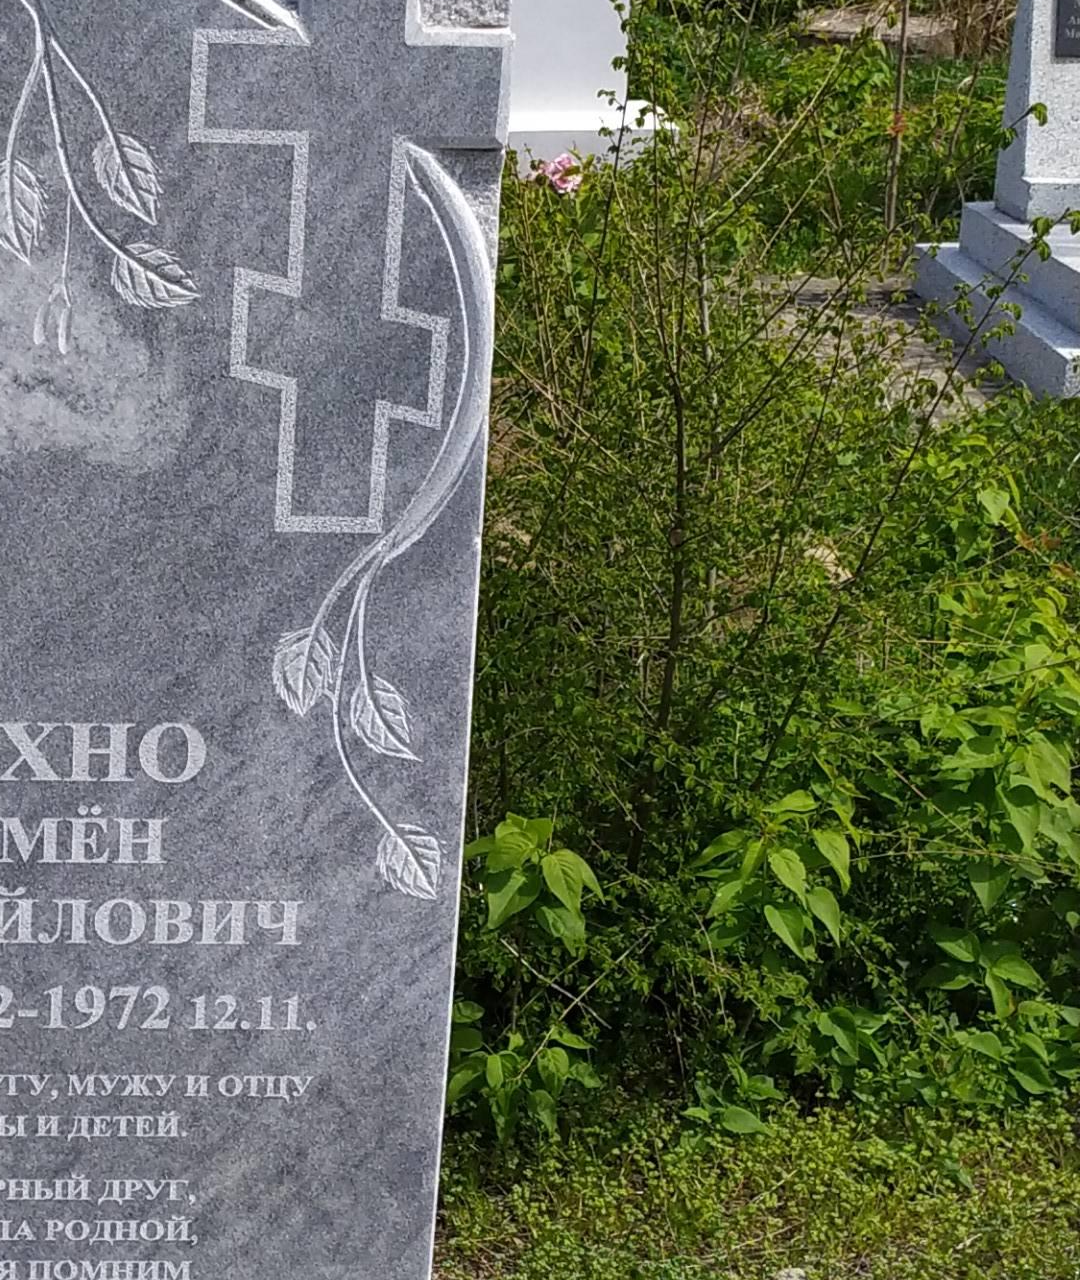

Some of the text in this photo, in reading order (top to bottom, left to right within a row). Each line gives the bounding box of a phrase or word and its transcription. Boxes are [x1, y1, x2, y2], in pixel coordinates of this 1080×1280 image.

[189, 994, 317, 1031] 12.11.
[67, 1074, 176, 1097] МУЖУ
[183, 1074, 210, 1097] И
[218, 1074, 314, 1102] ОТЦУ
[35, 1115, 60, 1138] И
[67, 1111, 188, 1142] ДЕТЕЙ.
[98, 1179, 198, 1205] ДРУГ,
[44, 1215, 200, 1246] РОДНОЙ,
